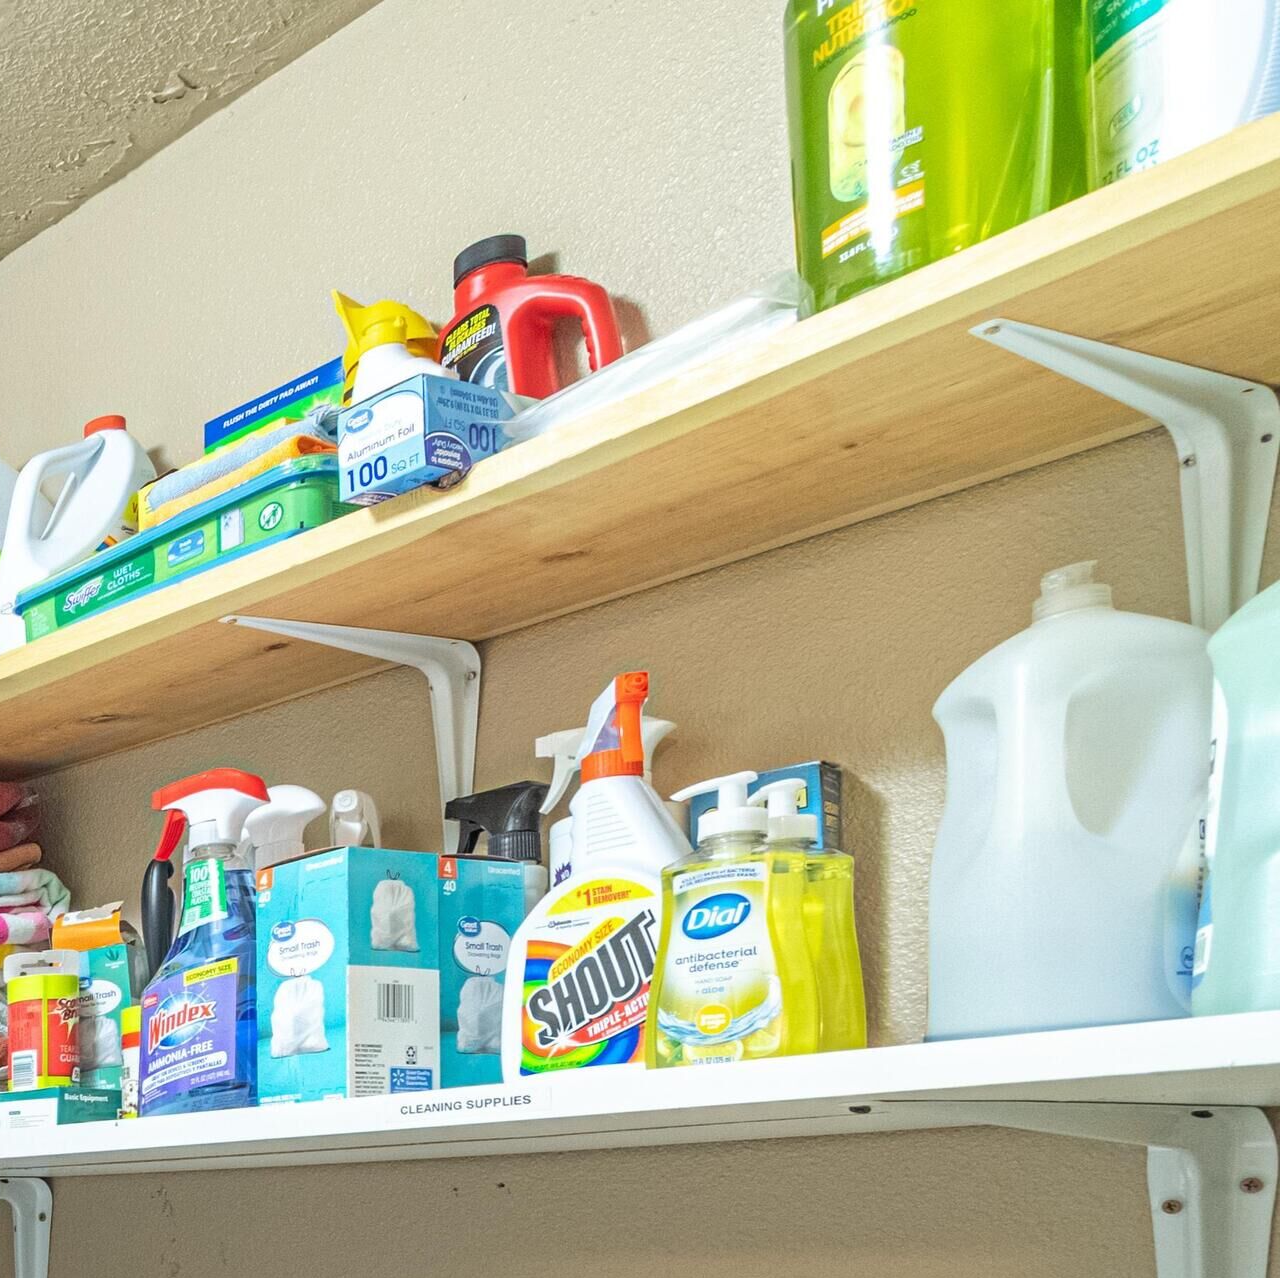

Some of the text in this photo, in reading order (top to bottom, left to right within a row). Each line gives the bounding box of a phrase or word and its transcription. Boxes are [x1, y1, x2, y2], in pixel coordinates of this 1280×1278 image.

[223, 376, 319, 429] FLUSH THE DIRTY PAD AWAY!
[347, 423, 415, 462] Aluminum Foil
[469, 423, 497, 453] 100
[347, 453, 420, 492] 100 SQ FT
[113, 562, 134, 579] WET
[64, 582, 102, 612] Swiffer
[107, 569, 141, 591] CLOTHS
[444, 861, 452, 873] 4
[687, 901, 746, 931] Dial
[279, 940, 320, 955] Small Trash
[465, 942, 503, 951] Small Trash
[552, 920, 614, 980] ECONOMY SIZE
[675, 946, 758, 966] antibacterial
[186, 964, 232, 982] ECONOMY SIZE
[529, 909, 656, 1046] SHOUT
[689, 959, 739, 973] defense
[95, 990, 117, 1000] Trash
[701, 986, 725, 994] aloe
[149, 1002, 216, 1053] Windex
[148, 1040, 213, 1074] AMMONIA-FREE
[400, 1095, 532, 1115] CLEANING SUPPLIES
